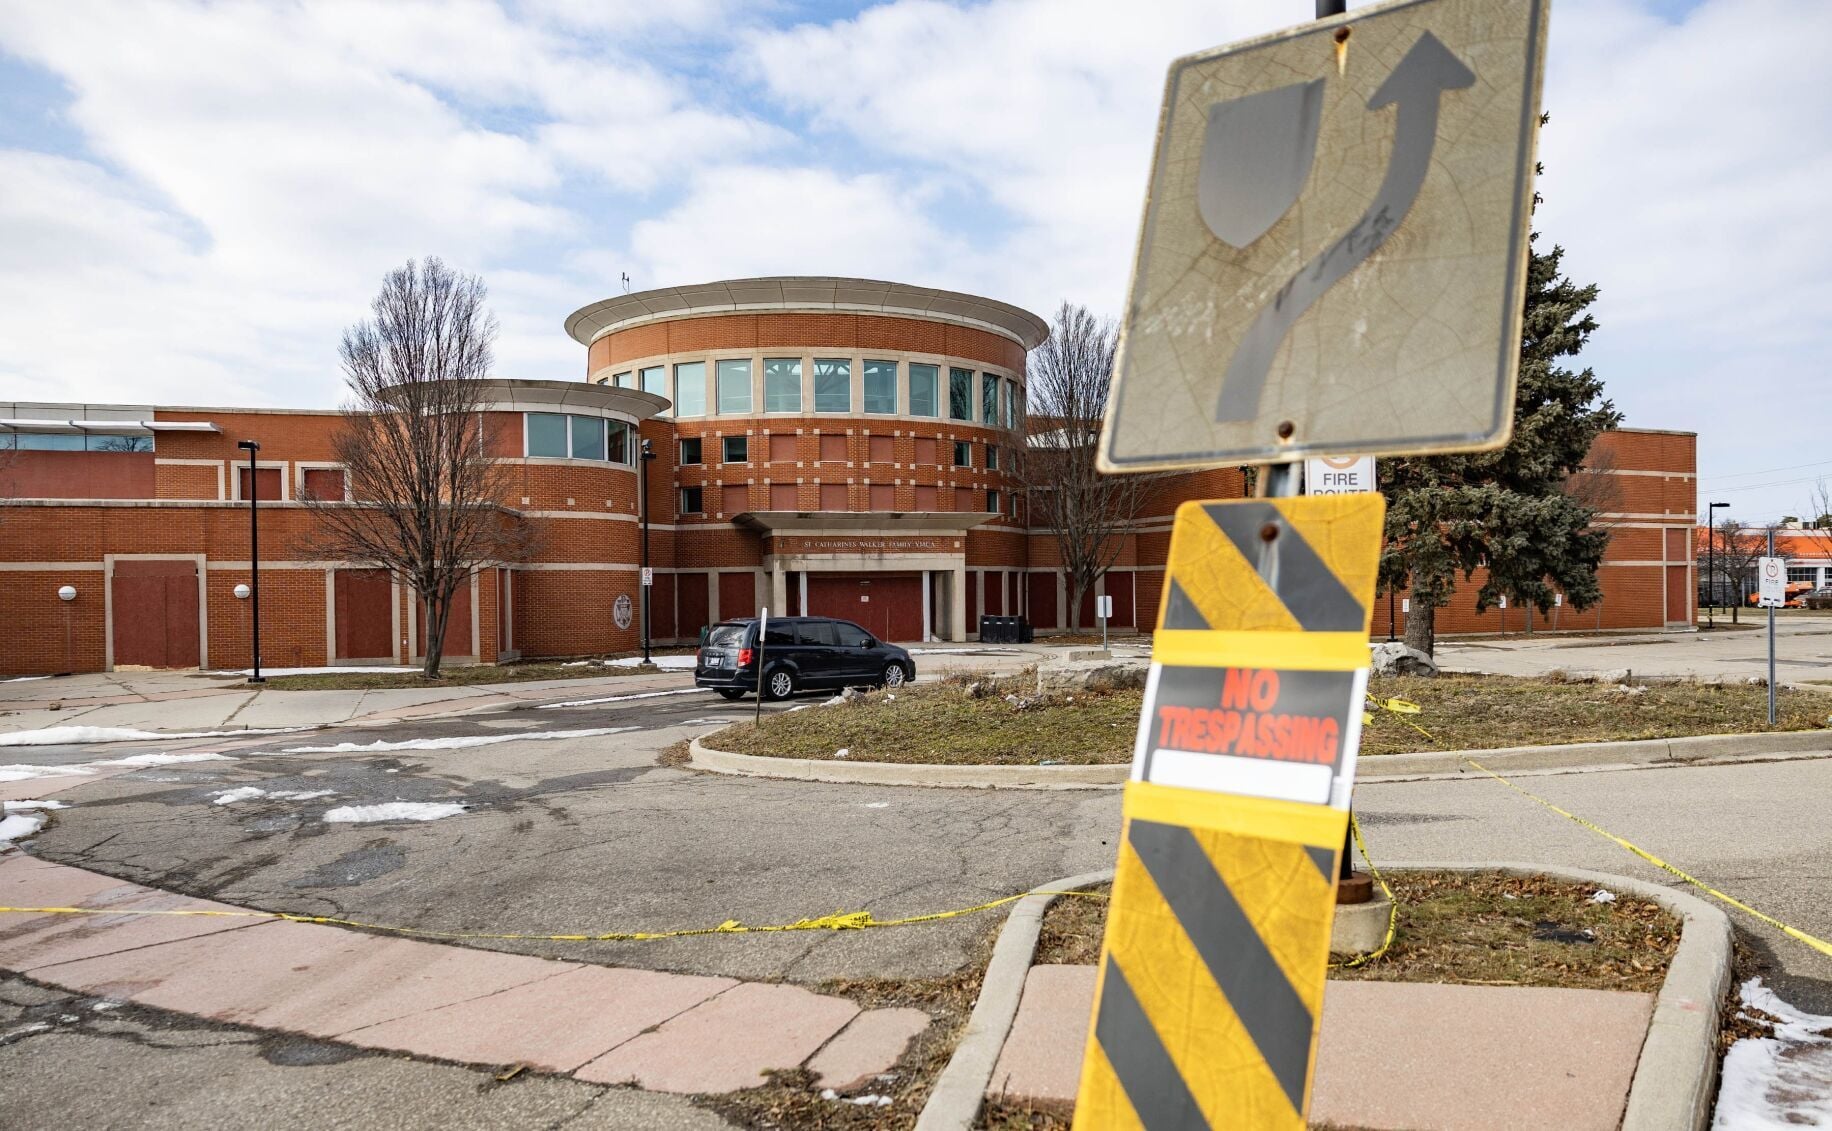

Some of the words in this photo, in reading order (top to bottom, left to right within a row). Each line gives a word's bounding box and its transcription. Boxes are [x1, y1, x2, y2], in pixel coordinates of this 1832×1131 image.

[1323, 472, 1358, 486] FIRE
[815, 541, 857, 549] CATHARINES
[1220, 667, 1280, 711] NO
[1157, 706, 1340, 764] TRESPASSING
